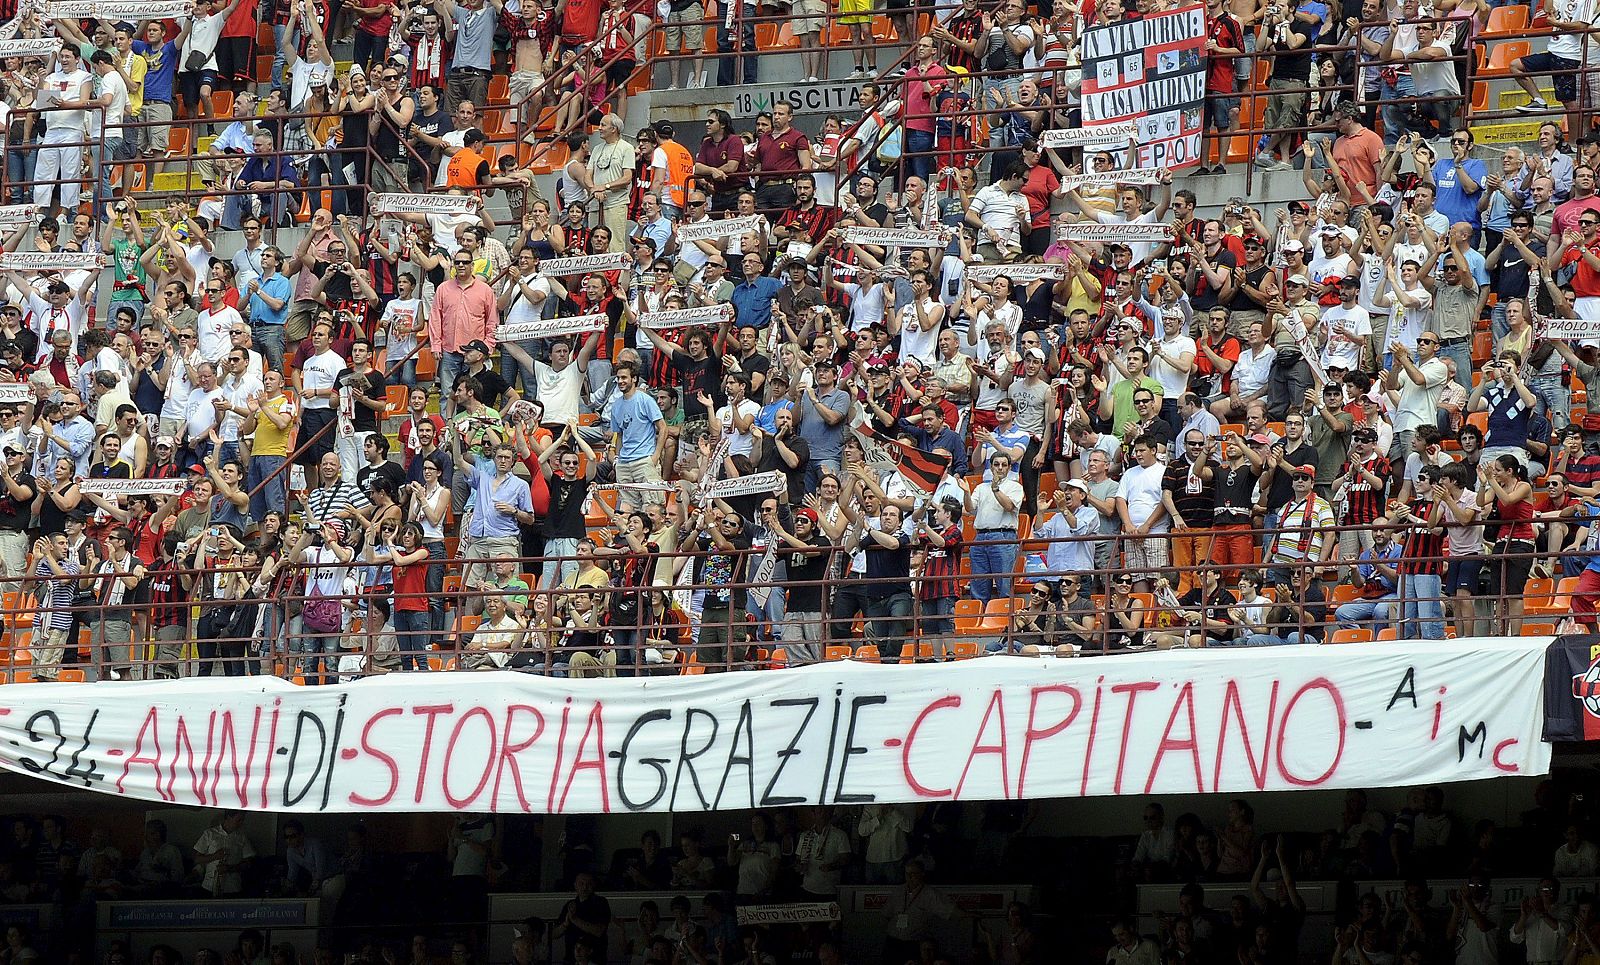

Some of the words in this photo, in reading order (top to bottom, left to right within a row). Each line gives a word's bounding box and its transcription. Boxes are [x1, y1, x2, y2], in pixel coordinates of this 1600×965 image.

[103, 4, 136, 14] PAOLO
[137, 3, 183, 13] MALDINI
[1084, 31, 1099, 59] IN
[1108, 24, 1137, 53] VIA
[1130, 62, 1138, 72] 65
[1103, 69, 1112, 78] 64
[736, 93, 752, 113] 18
[770, 87, 861, 111] USCITA
[1084, 94, 1096, 121] A
[1101, 88, 1135, 119] CASA
[1148, 126, 1158, 135] 03
[1166, 121, 1175, 131] 07
[1154, 133, 1201, 168] PAOLO
[386, 196, 418, 206] PAOLO
[420, 197, 466, 207] MALDINI
[857, 230, 889, 239] PAOLO
[891, 231, 937, 241] MALDINI
[1069, 225, 1107, 235] PAOLO
[1109, 225, 1162, 235] MALDINI
[12, 253, 44, 263] PAOLO
[46, 254, 95, 263] MALDINI
[541, 260, 573, 271] PAOLO
[575, 255, 620, 268] MALDINI
[978, 268, 1008, 276] PAOLO
[649, 311, 678, 322] PAOLO
[679, 307, 721, 319] MALDINI
[507, 322, 540, 334] PAOLO
[543, 317, 593, 331] MALDINI
[1550, 322, 1588, 332] PAOLO
[90, 481, 124, 490] PAOLO
[126, 481, 174, 490] MALDINI
